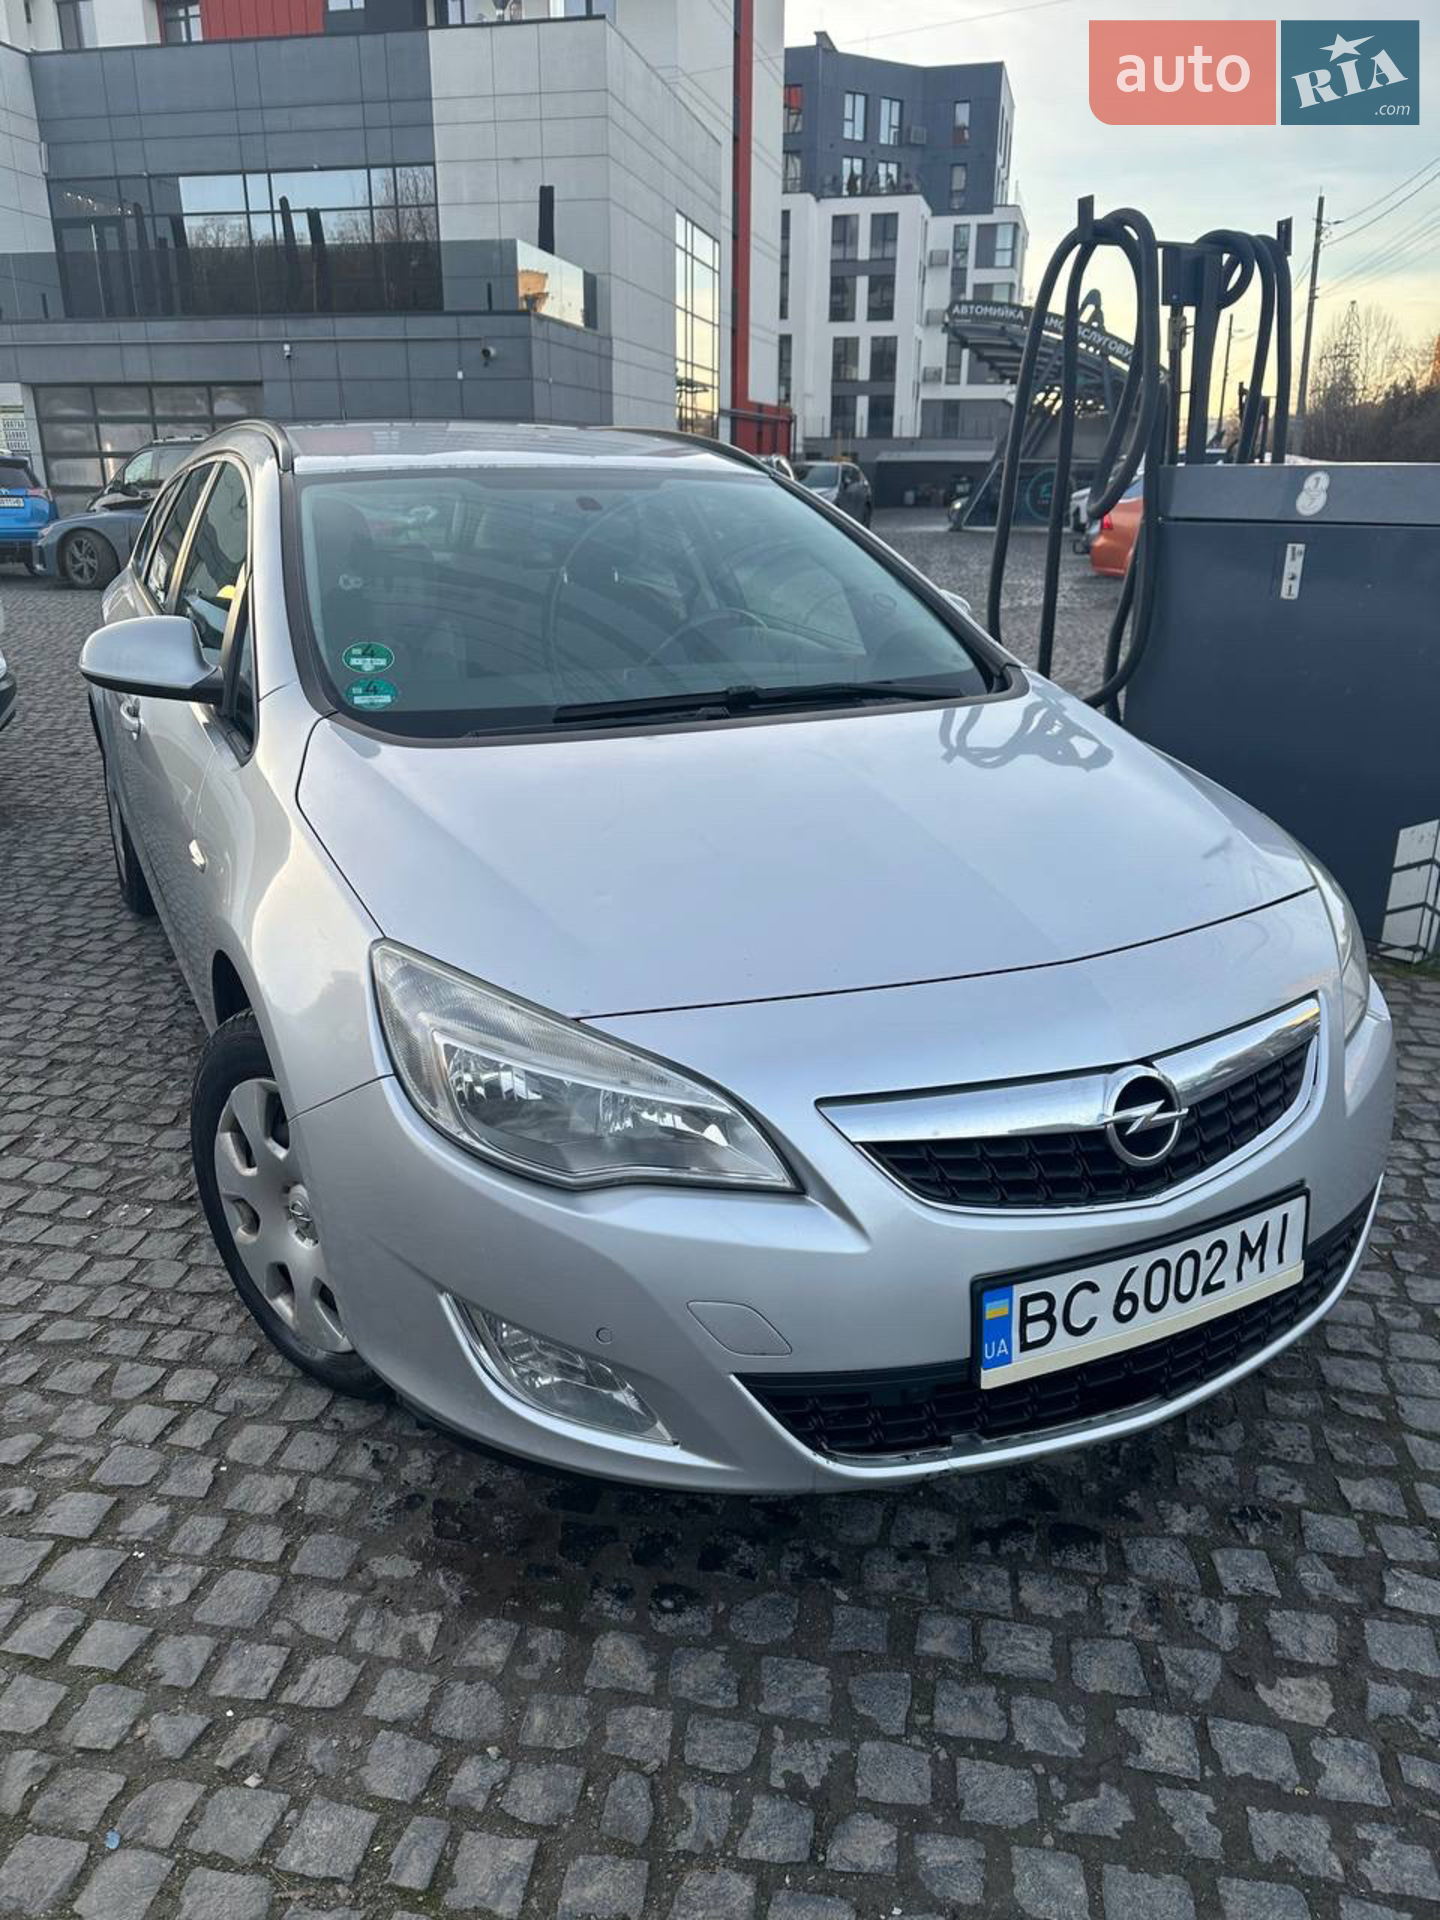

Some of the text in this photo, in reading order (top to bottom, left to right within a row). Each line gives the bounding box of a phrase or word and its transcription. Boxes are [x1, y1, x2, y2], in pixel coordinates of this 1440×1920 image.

[952, 303, 1025, 322] АВТОМИЙКА
[361, 644, 376, 658] 4
[365, 680, 379, 694] 4
[1018, 1212, 1290, 1354] BC 6002 MI
[985, 1338, 1009, 1359] UA
